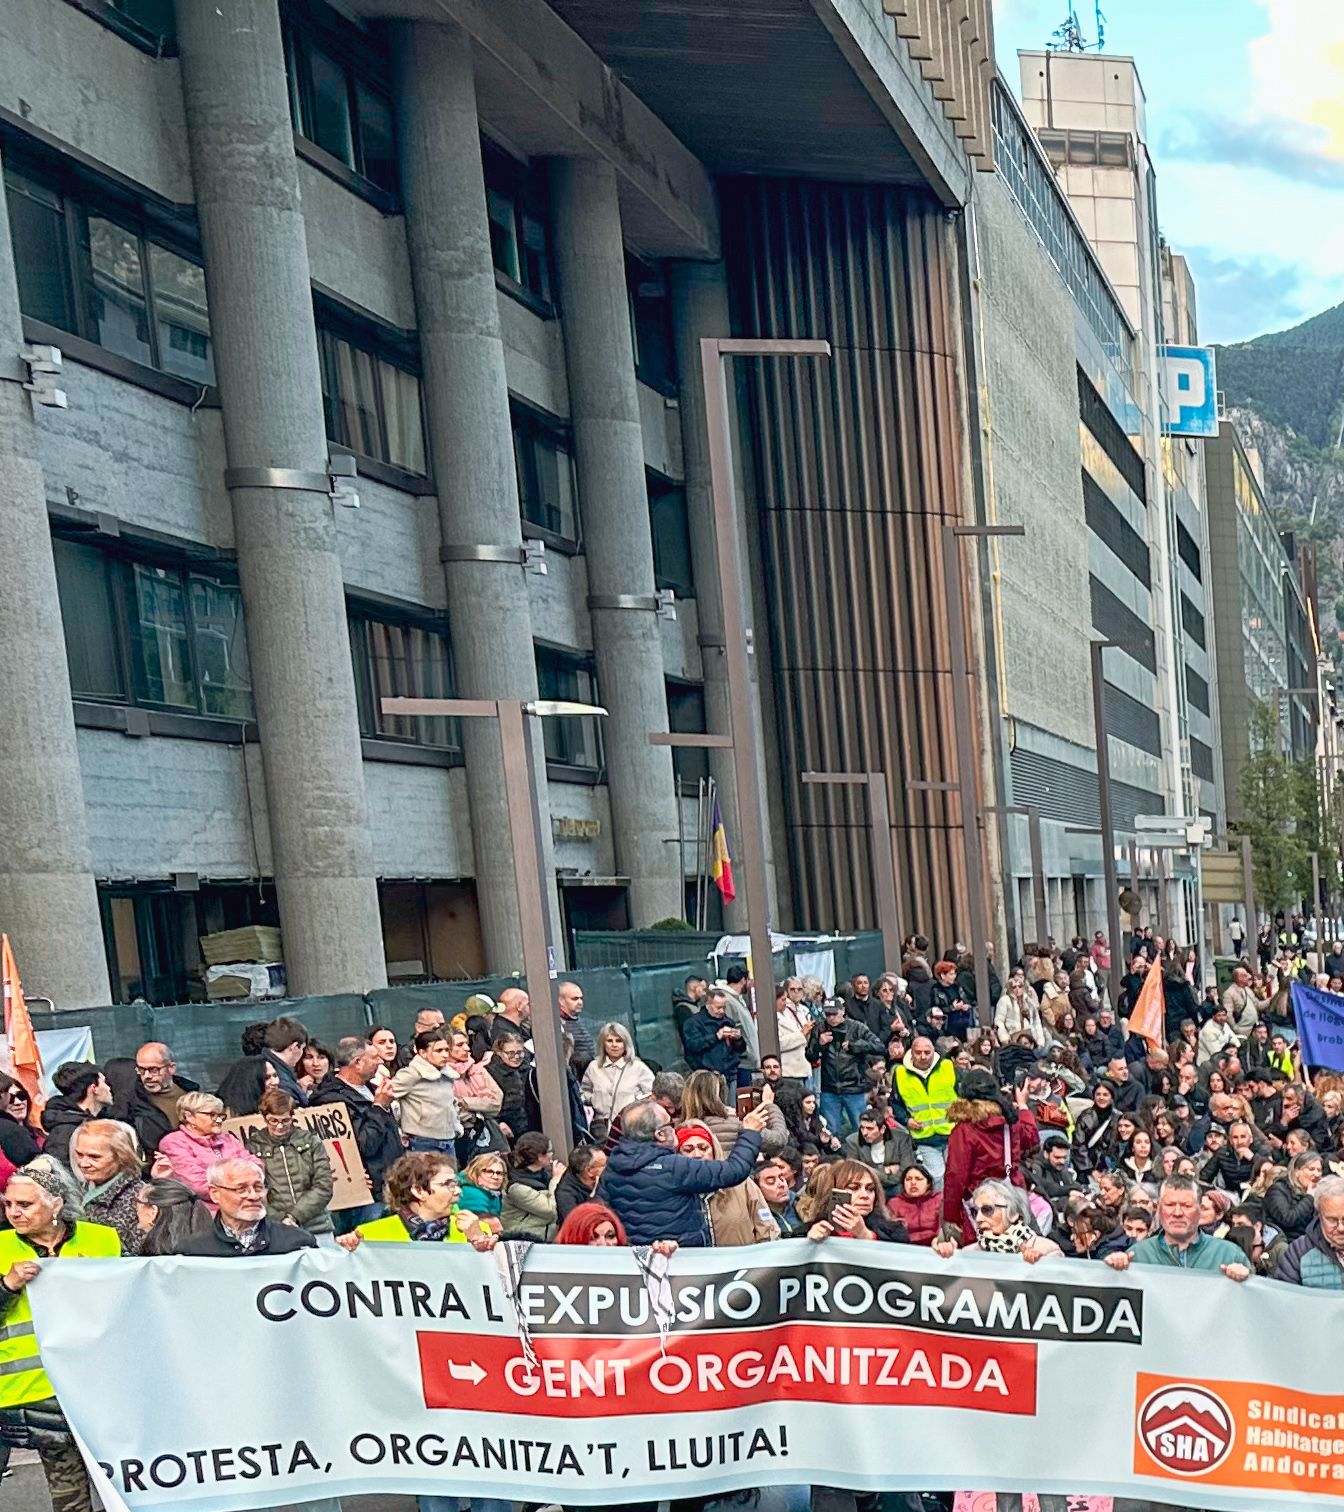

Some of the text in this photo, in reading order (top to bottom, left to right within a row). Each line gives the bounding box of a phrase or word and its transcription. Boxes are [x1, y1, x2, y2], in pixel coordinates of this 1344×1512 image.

[256, 1269, 1141, 1338] CONTRA LEXPUSIÓ PROGRAMADA
[504, 1343, 1009, 1398] GENT ORGANITZADA
[349, 1432, 631, 1479] ORGANITZA'T,
[647, 1424, 790, 1472] LLUITA!
[1159, 1432, 1209, 1463] SHA
